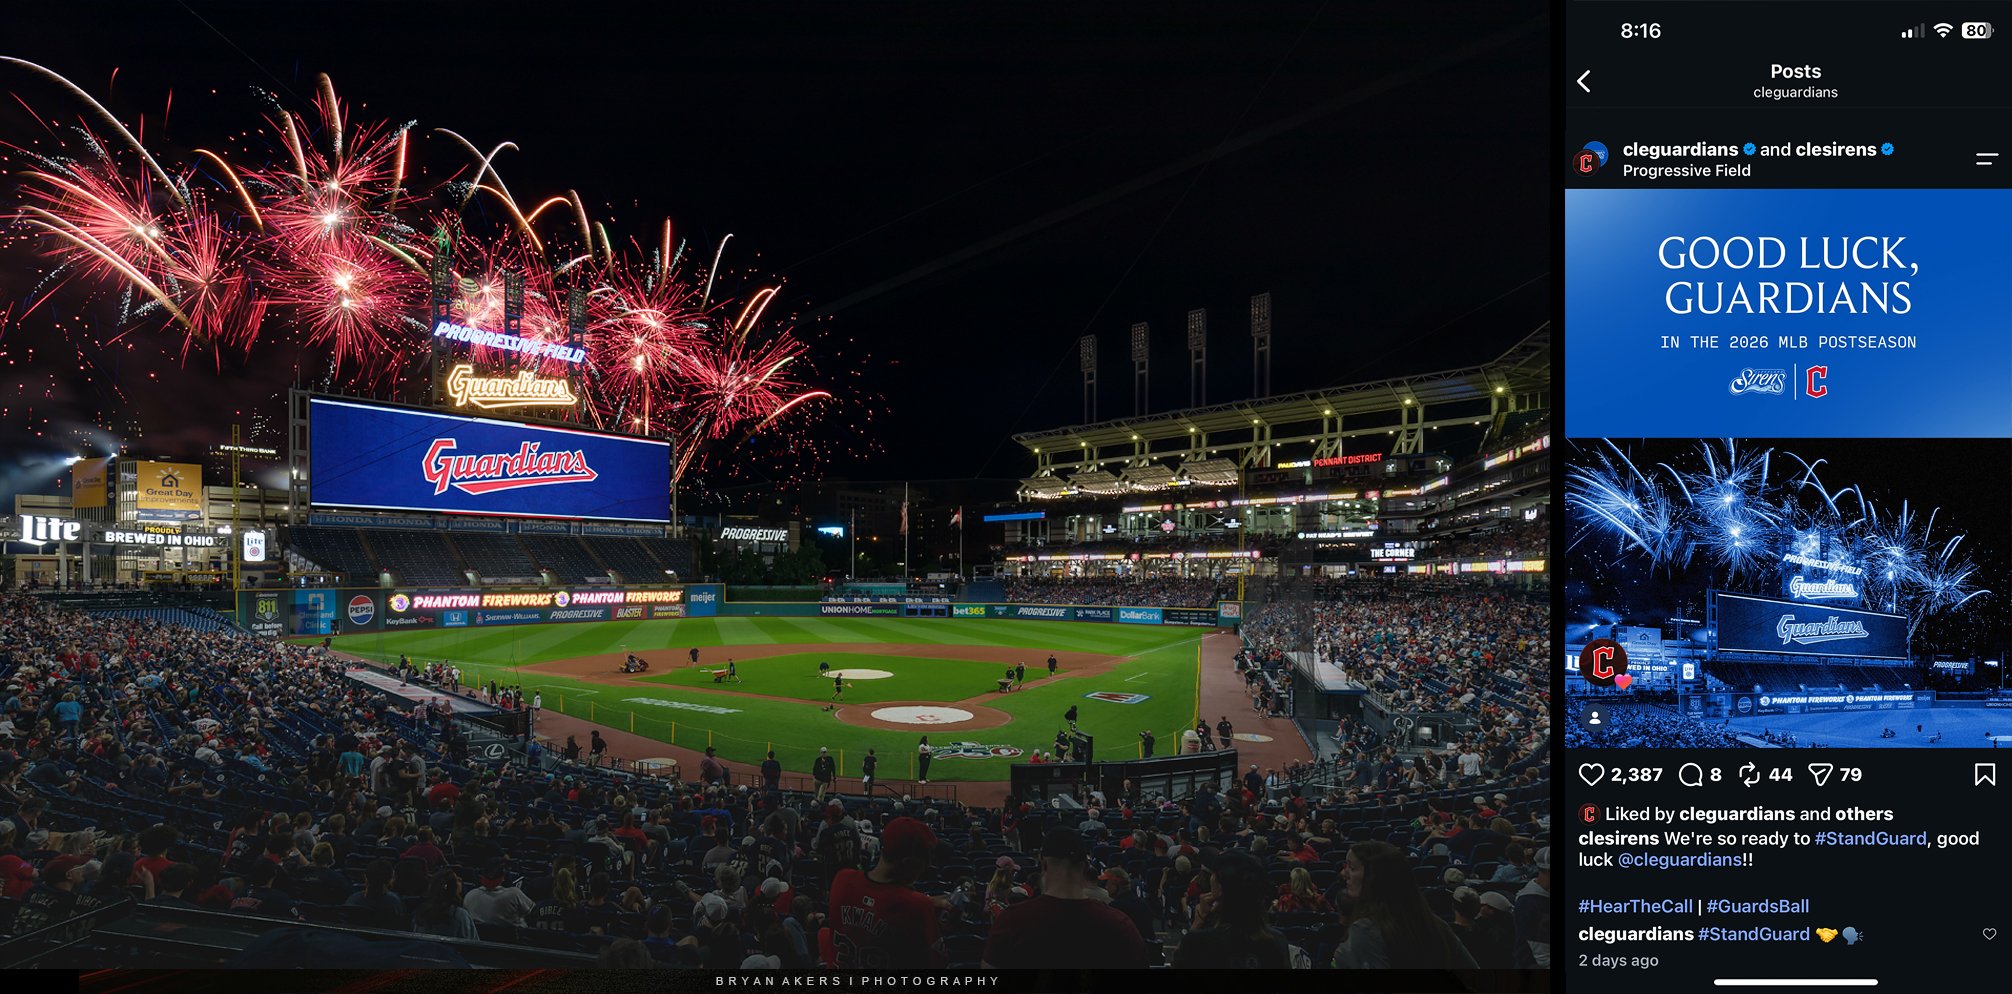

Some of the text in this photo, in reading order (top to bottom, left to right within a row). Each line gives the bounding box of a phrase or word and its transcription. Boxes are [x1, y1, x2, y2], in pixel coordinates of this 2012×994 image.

[1620, 22, 1662, 39] 8:16
[1966, 24, 1986, 37] 80
[1771, 63, 1822, 79] Posts
[1753, 85, 1839, 100] cleguardians
[1623, 141, 1878, 160] cleguardians and clesirens
[1623, 163, 1751, 180] Progressive Field
[1658, 235, 1919, 277] GOOD LUCK,
[1665, 280, 1912, 316] GUARDIANS
[433, 321, 586, 364] PROGRESSIVE FIELD
[1660, 335, 1917, 349] IN THE 2026 MLB POSTSEASON
[447, 364, 578, 408] Guardians
[1730, 368, 1785, 393] Sirens
[239, 446, 259, 454] THIRD
[422, 438, 599, 496] Guardians
[1313, 453, 1383, 468] PENNANT DISTRICT
[146, 488, 193, 499] Great Day
[324, 516, 373, 524] HONDA
[387, 518, 432, 527] HONDA
[462, 521, 503, 529] HONDA
[19, 514, 81, 546] Lite
[144, 526, 181, 534] PROUDLY
[531, 524, 567, 532] HONDA
[720, 527, 788, 541] PROGRESSIVE
[105, 531, 214, 546] BREWED IN OHIO
[246, 537, 263, 547] Lite
[1370, 548, 1415, 558] THE CORNER
[1790, 576, 1858, 599] Guardians
[412, 592, 553, 609] PHANTOM FIREWORKS
[571, 591, 624, 604] PHANTOM
[625, 589, 682, 603] FIREWORKS
[690, 592, 716, 604] meijer
[257, 600, 277, 613] 811
[350, 606, 373, 614] PEPSI
[616, 607, 643, 618] BLASTER
[953, 606, 986, 615] bet365
[1017, 606, 1067, 617] PROGRESSIVE
[386, 617, 418, 627] KeyBank
[550, 609, 604, 620] PROGRESSIVE
[1777, 615, 1869, 645] Guardians
[1933, 661, 1969, 669] PROGRESSIVE
[1771, 695, 1845, 704] PHANTOM FIREWORKS
[1610, 767, 1663, 784] 2,387
[1709, 767, 1722, 782] 8
[1768, 767, 1793, 782] 44
[1839, 767, 1863, 782] 79
[1605, 805, 1894, 825] Liked by cleguardians and others
[1578, 829, 1980, 849] clesirens We're so ready to #StandGuard, good
[1578, 851, 1753, 870] luck @cleguardians!!
[1578, 898, 1693, 914] #HearTheCall
[1706, 898, 1810, 914] #GuardsBall
[840, 905, 889, 937] KWAN
[1578, 925, 1810, 945] cleguardians #StandGuard
[1578, 953, 1659, 970] 2 days ago
